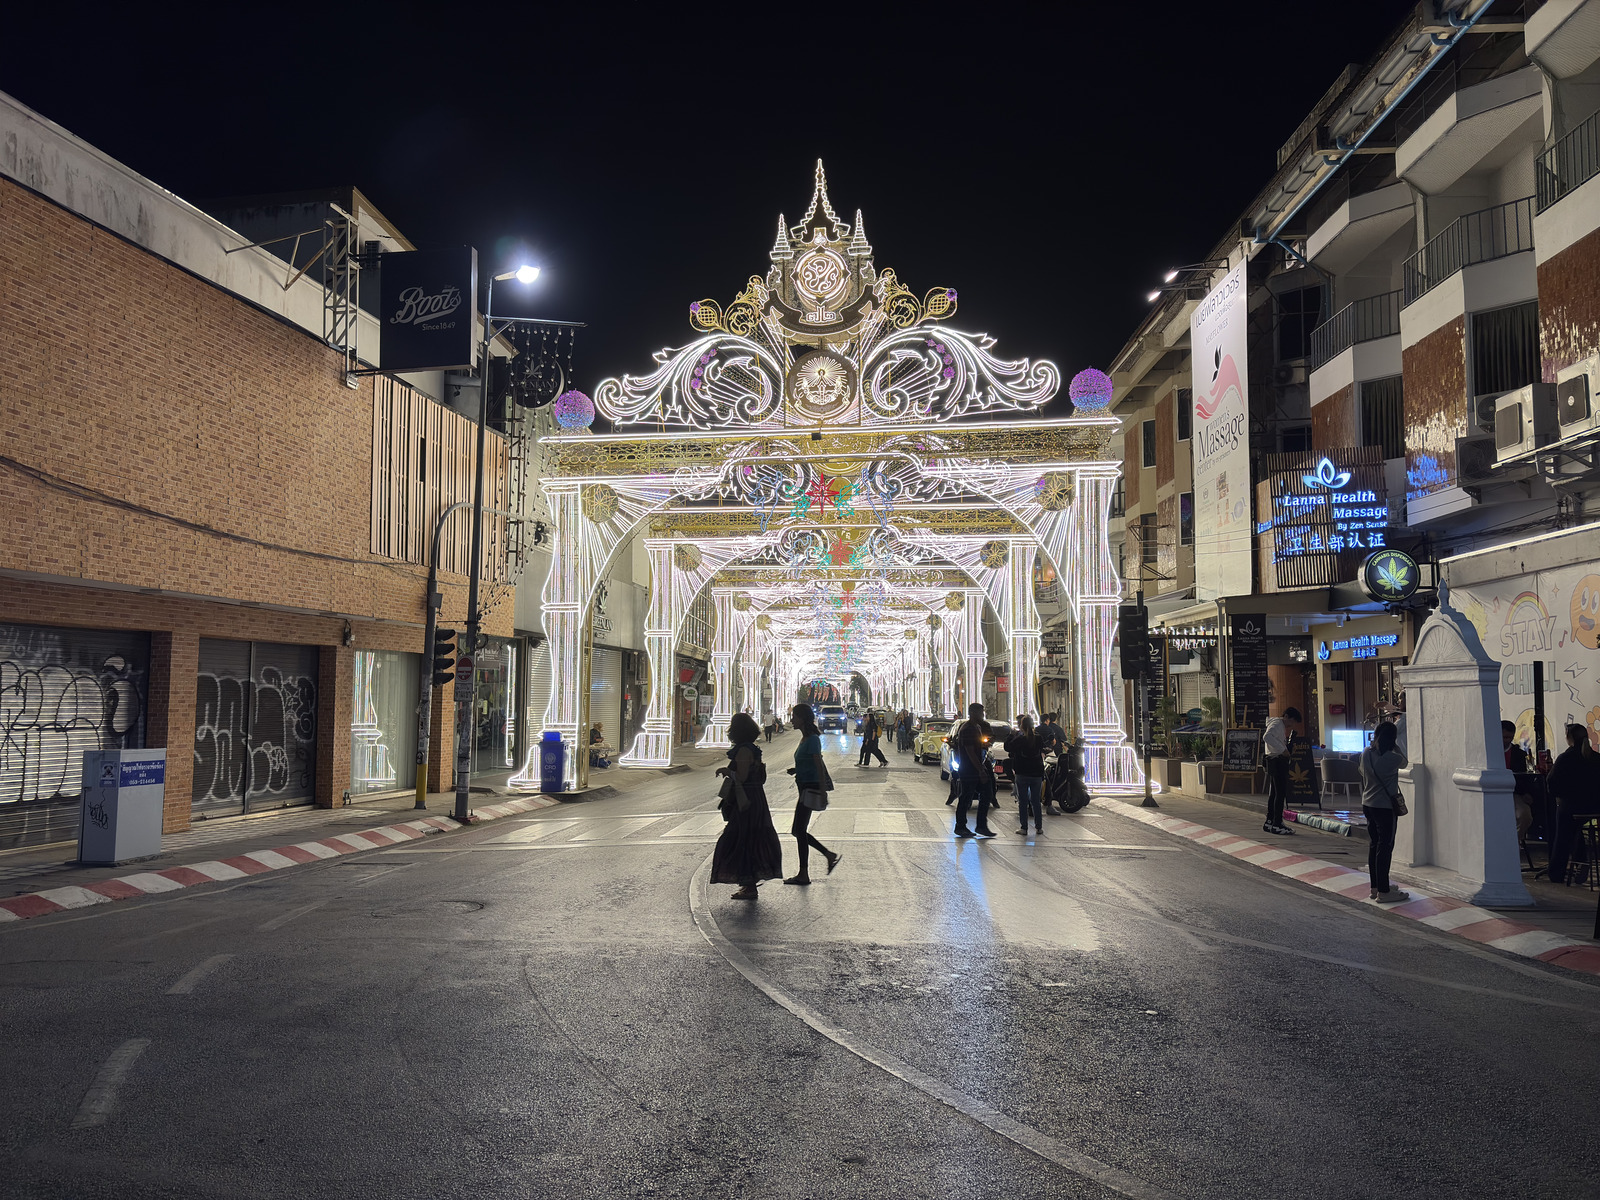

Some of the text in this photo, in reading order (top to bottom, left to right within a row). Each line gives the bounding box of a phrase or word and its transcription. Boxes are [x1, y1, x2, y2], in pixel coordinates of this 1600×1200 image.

[390, 286, 462, 325] Boots
[422, 321, 456, 331] Since 1849
[1198, 412, 1245, 463] Massage
[1284, 490, 1376, 506] Lanna Health
[1333, 507, 1388, 520] Massage
[1337, 521, 1388, 532] By Zen Sense
[1371, 552, 1414, 567] CANNABIS DISPENSARY
[1332, 634, 1397, 650] Lanna Health Massage
[1501, 616, 1557, 657] STAY
